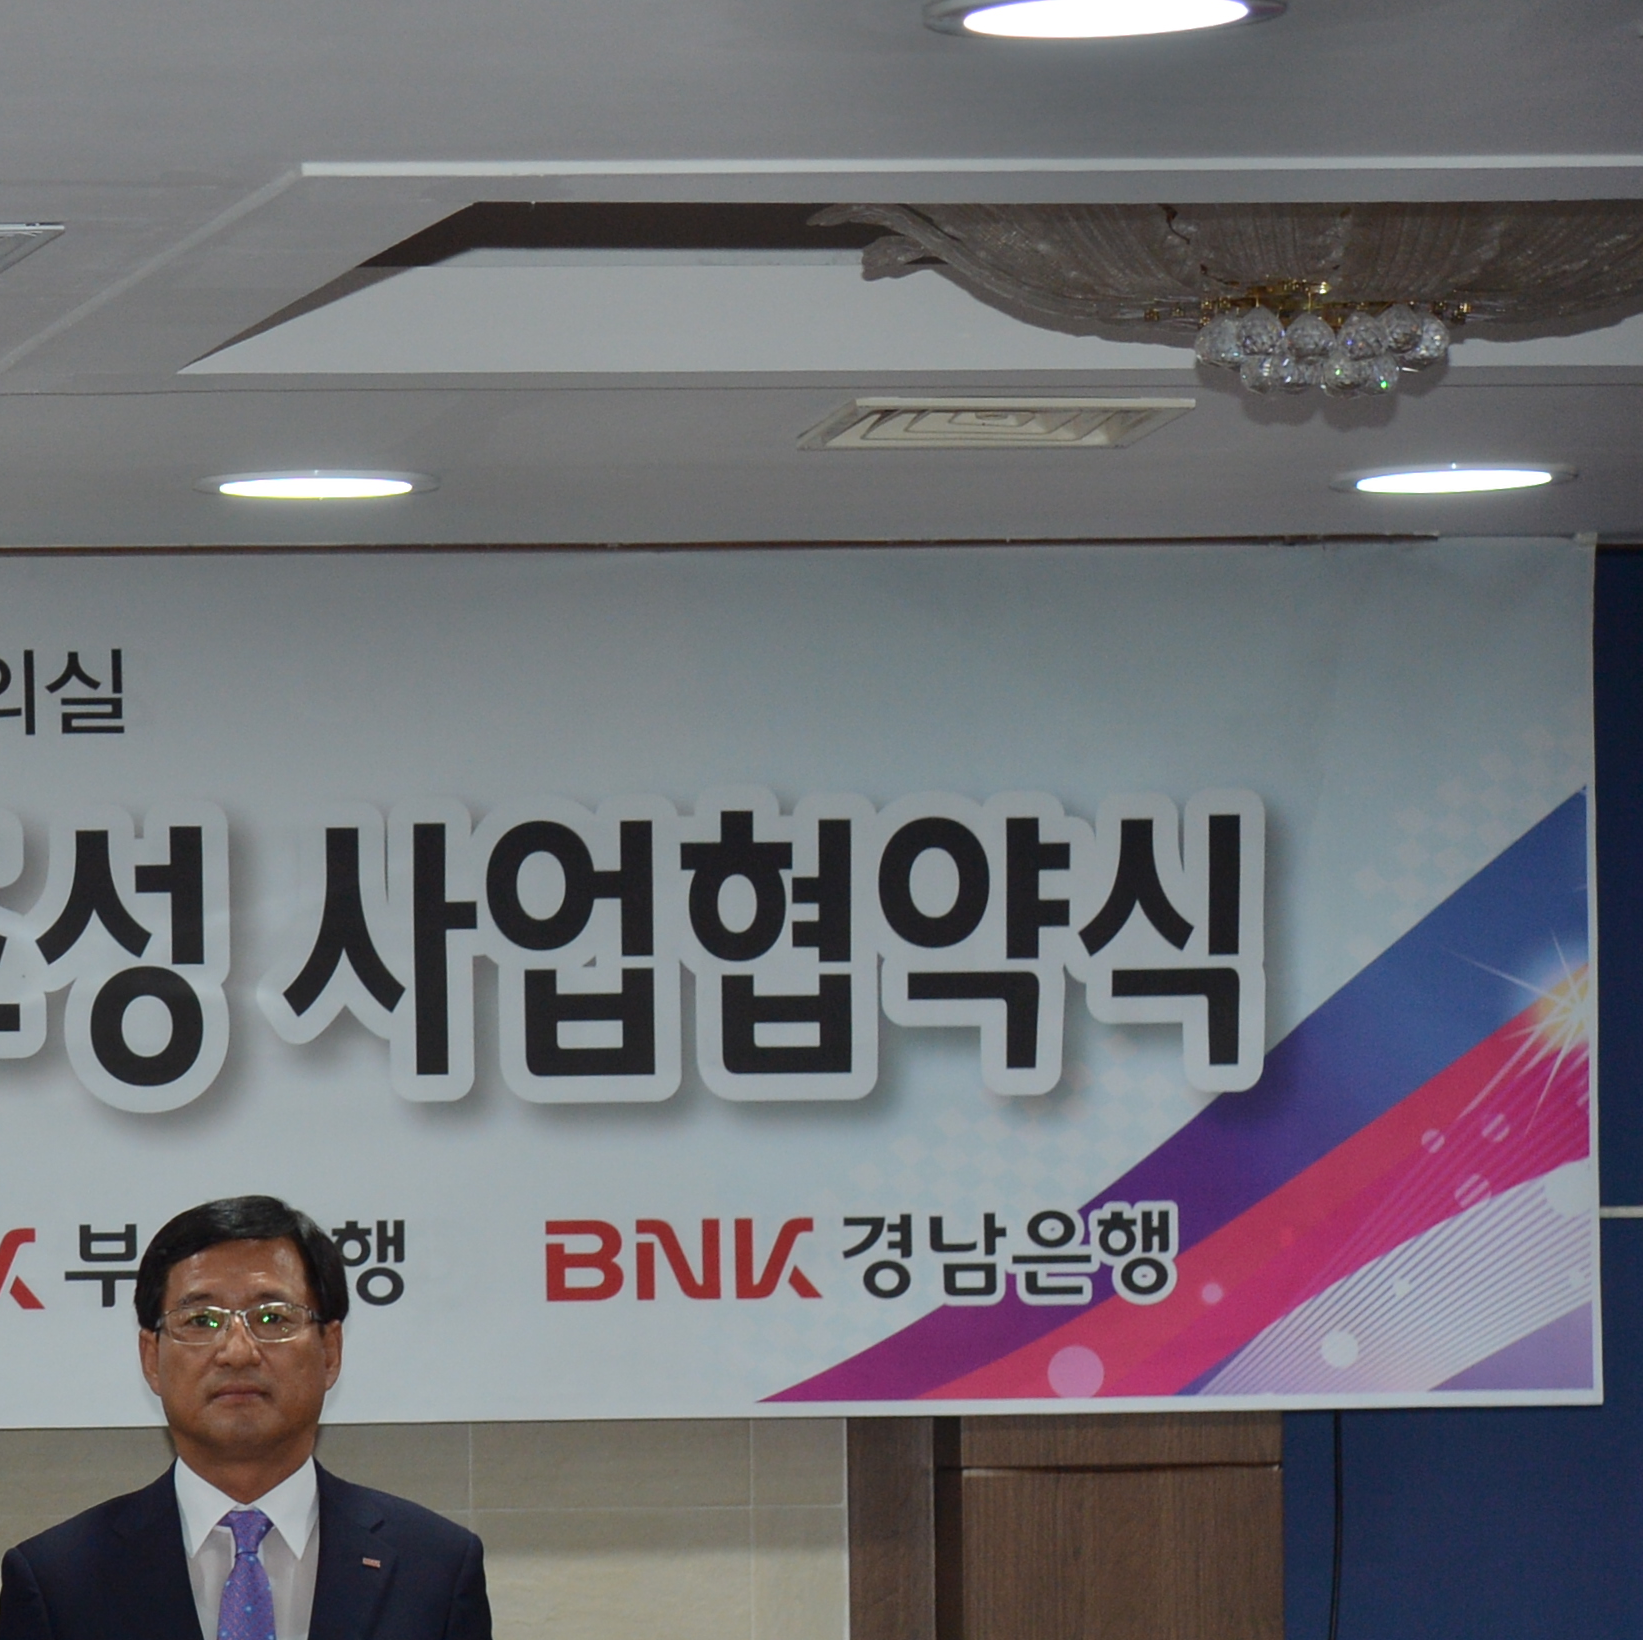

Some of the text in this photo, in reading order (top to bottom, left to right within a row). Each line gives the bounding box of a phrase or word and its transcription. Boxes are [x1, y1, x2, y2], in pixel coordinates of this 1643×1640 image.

[282, 811, 1242, 1078] 사업협약식
[545, 1209, 1173, 1307] BNK 경남은행
